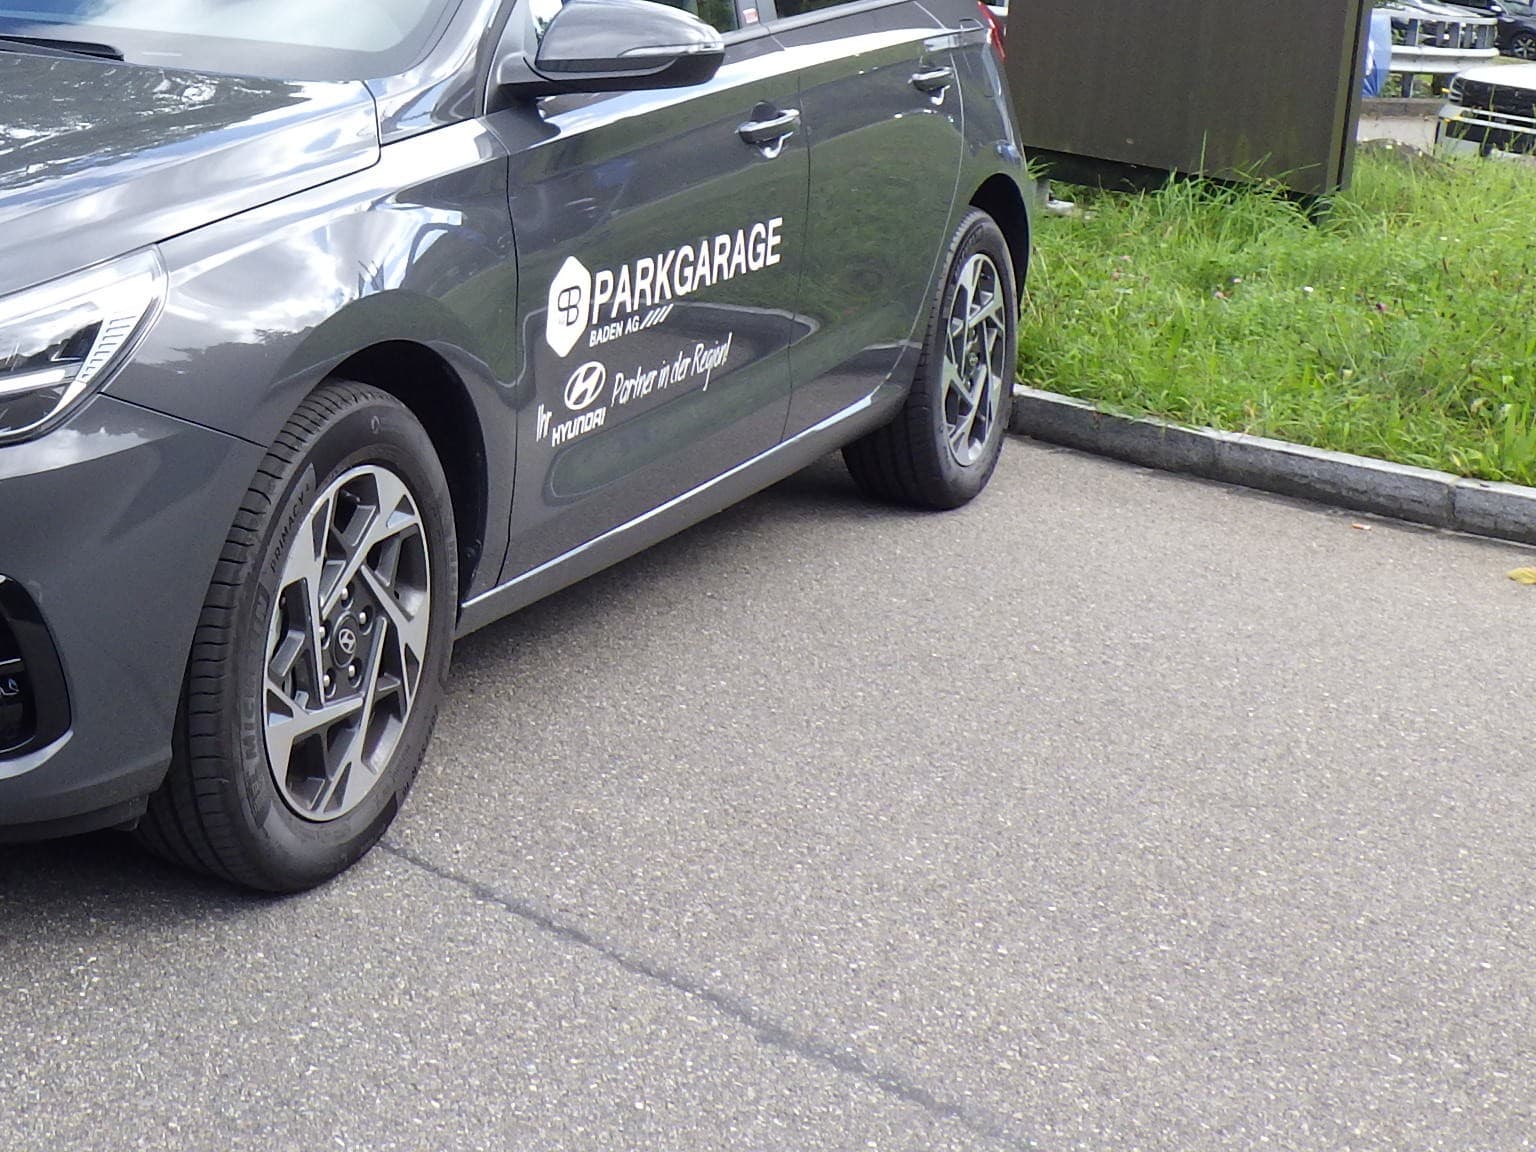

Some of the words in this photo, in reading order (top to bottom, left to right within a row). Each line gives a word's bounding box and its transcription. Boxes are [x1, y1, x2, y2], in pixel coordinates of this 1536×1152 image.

[592, 217, 783, 325] PARKGARAGE
[589, 321, 623, 348] BADEN
[625, 315, 640, 335] AG
[536, 404, 552, 442] Ihr
[552, 407, 606, 447] HYUNDAI
[611, 366, 658, 408] Partner
[657, 360, 670, 390] in
[670, 351, 692, 384] der
